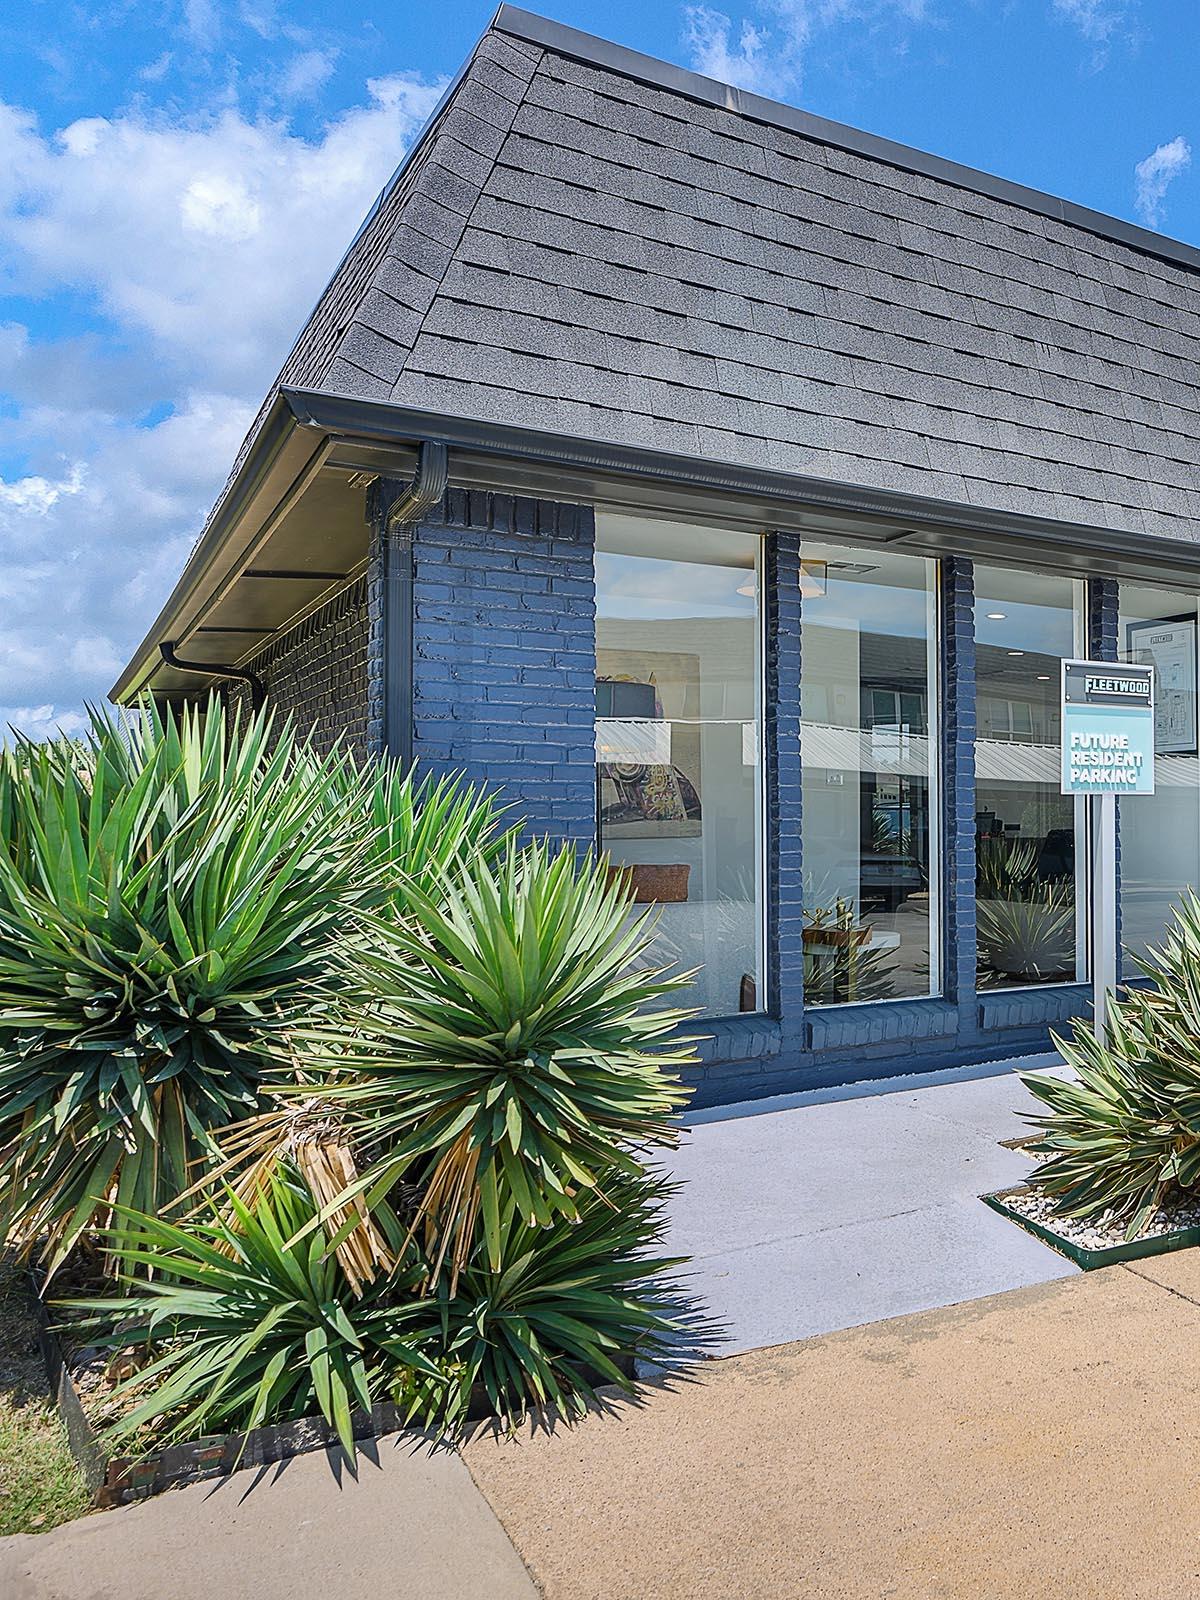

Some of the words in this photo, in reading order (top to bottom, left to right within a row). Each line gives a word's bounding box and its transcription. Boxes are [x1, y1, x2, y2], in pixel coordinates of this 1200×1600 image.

[1085, 678, 1149, 693] FLEETWOOD
[1071, 733, 1128, 749] FUTURE
[1071, 751, 1142, 766] RESIDENT
[1071, 768, 1136, 783] PARKING
